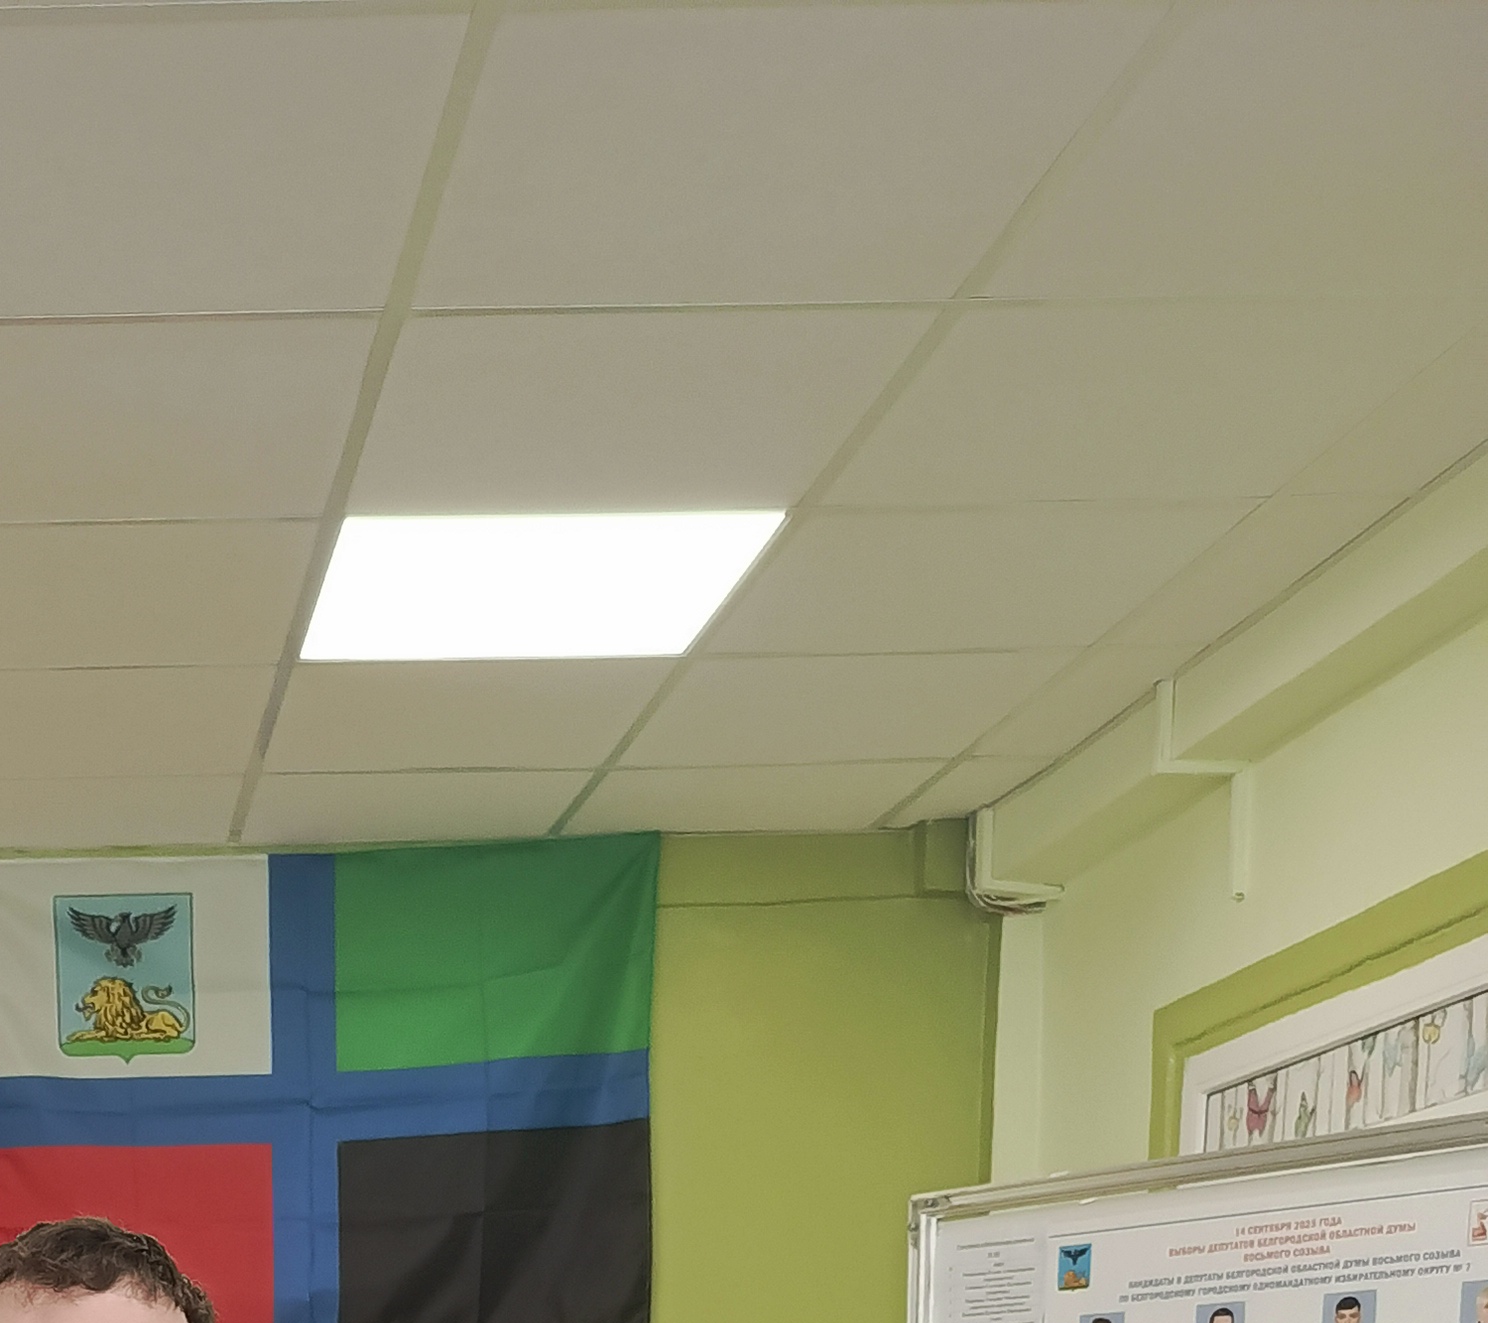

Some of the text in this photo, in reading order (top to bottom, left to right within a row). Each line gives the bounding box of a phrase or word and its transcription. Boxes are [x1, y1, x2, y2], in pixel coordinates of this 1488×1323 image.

[1319, 1216, 1342, 1227] ГОДА
[1169, 1222, 1416, 1257] ВЫБОРЫ ДЕПУТАТОВ БЕЛГОРОДСКОЙ ОБЛАСТНОЙ ДУМЫ
[1243, 1245, 1330, 1262] ВОСЬМОГО СОЗЫВА
[1128, 1276, 1174, 1289] КАНДИДАТЫ
[1183, 1272, 1224, 1285] ДЕПУТАТЫ
[1226, 1264, 1289, 1280] БЕЛГОРОДСКОЙ
[1291, 1258, 1340, 1273] ОБЛАСТНОЙ
[1342, 1257, 1369, 1270] ДУМЫ
[1372, 1253, 1420, 1266] ВОСЬМОГО
[1423, 1249, 1461, 1261] СОЗЫВА
[1131, 1289, 1195, 1303] БЕЛГОРОДСКОМУ
[1198, 1283, 1251, 1297] ГОРОДСКОМУ
[1252, 1275, 1333, 1292] ОДНОМАНДАТНОМУ
[1335, 1268, 1415, 1283] ИЗБИРАТЕЛЬНОМУ
[1418, 1264, 1451, 1276] ОКРУГУ
